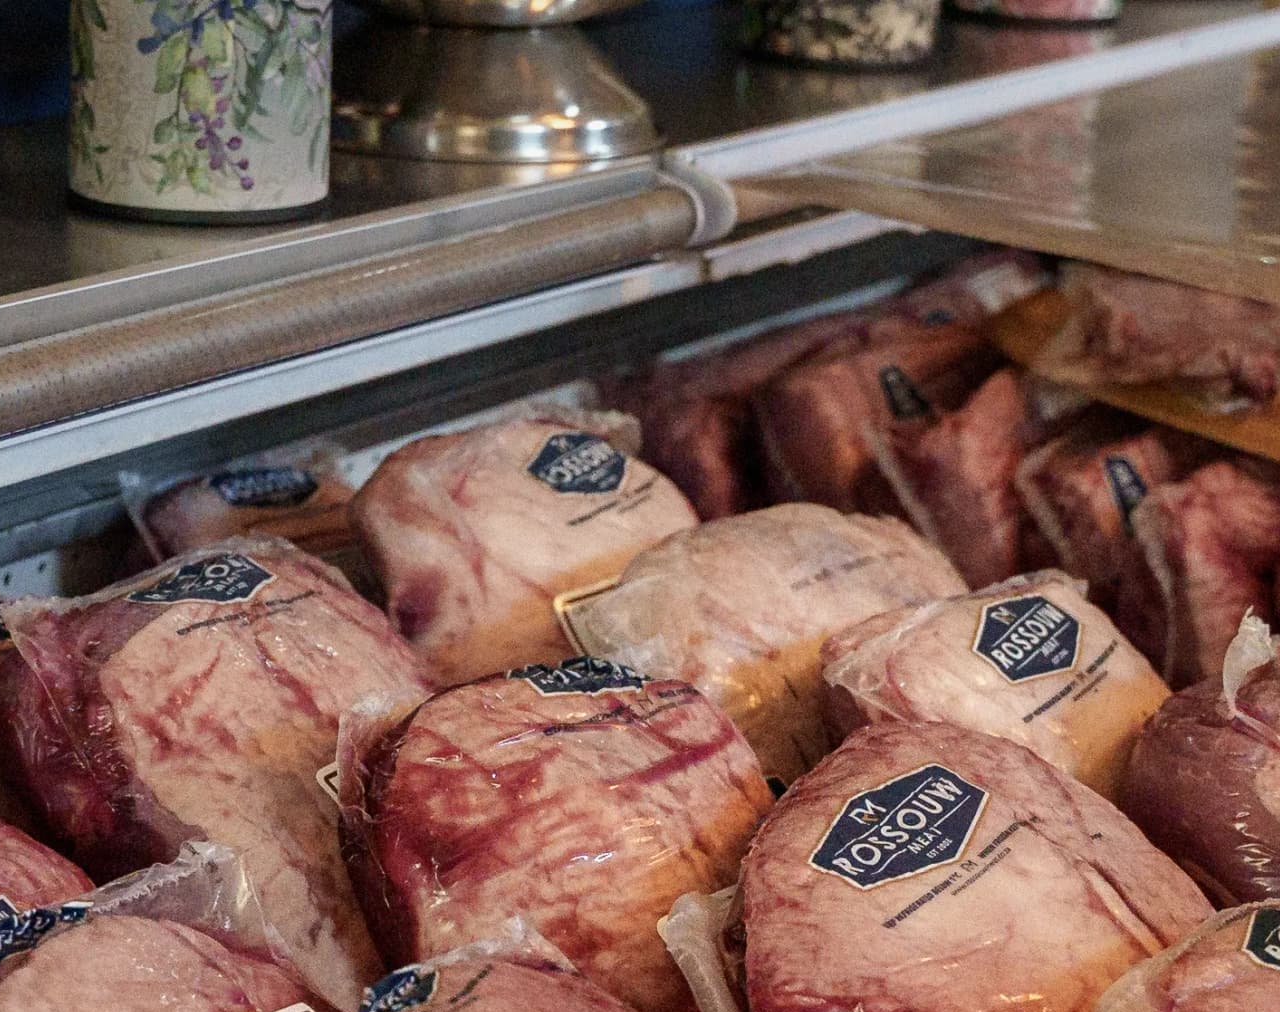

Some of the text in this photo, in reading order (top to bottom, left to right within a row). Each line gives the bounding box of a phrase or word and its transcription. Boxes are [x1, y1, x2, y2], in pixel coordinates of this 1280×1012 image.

[990, 603, 1067, 669] ROSSOUW
[831, 777, 964, 877] ROSSOUW
[904, 824, 944, 856] MEAT
